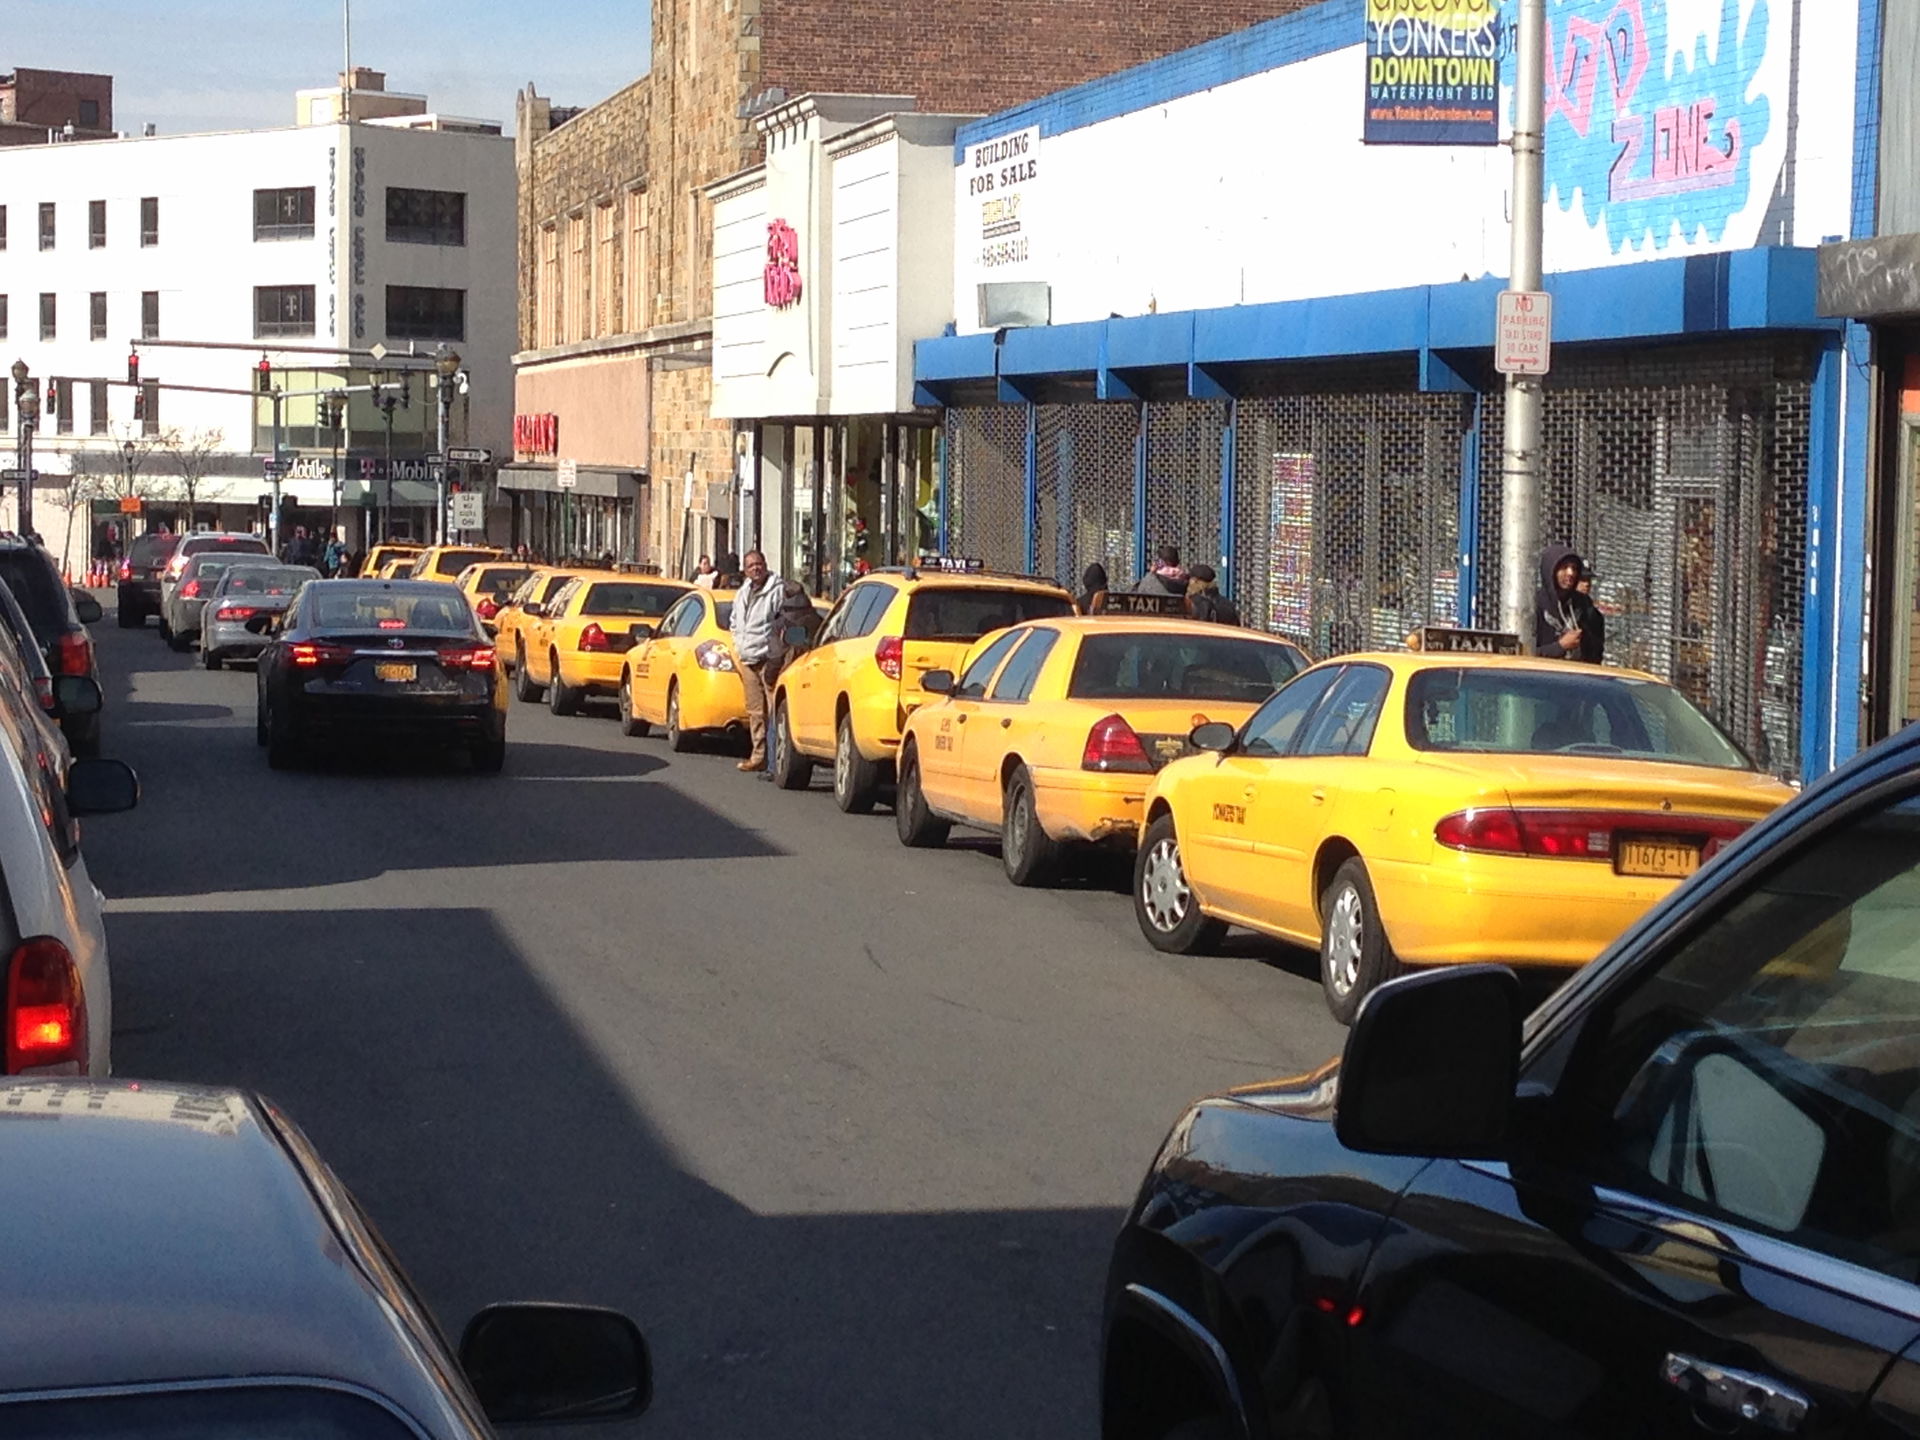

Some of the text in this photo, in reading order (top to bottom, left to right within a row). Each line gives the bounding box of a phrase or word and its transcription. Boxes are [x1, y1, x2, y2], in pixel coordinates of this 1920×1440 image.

[1370, 12, 1496, 57] YONKERS
[1370, 56, 1495, 86] DOWNTOWN
[1370, 86, 1495, 101] WATERFRONT BID
[975, 132, 1029, 169] BUILDING
[970, 159, 1037, 197] FOR SALE
[1515, 297, 1534, 312] NO
[940, 558, 966, 569] TAXI
[1128, 596, 1160, 613] TAXI
[1449, 634, 1493, 652] TAXI
